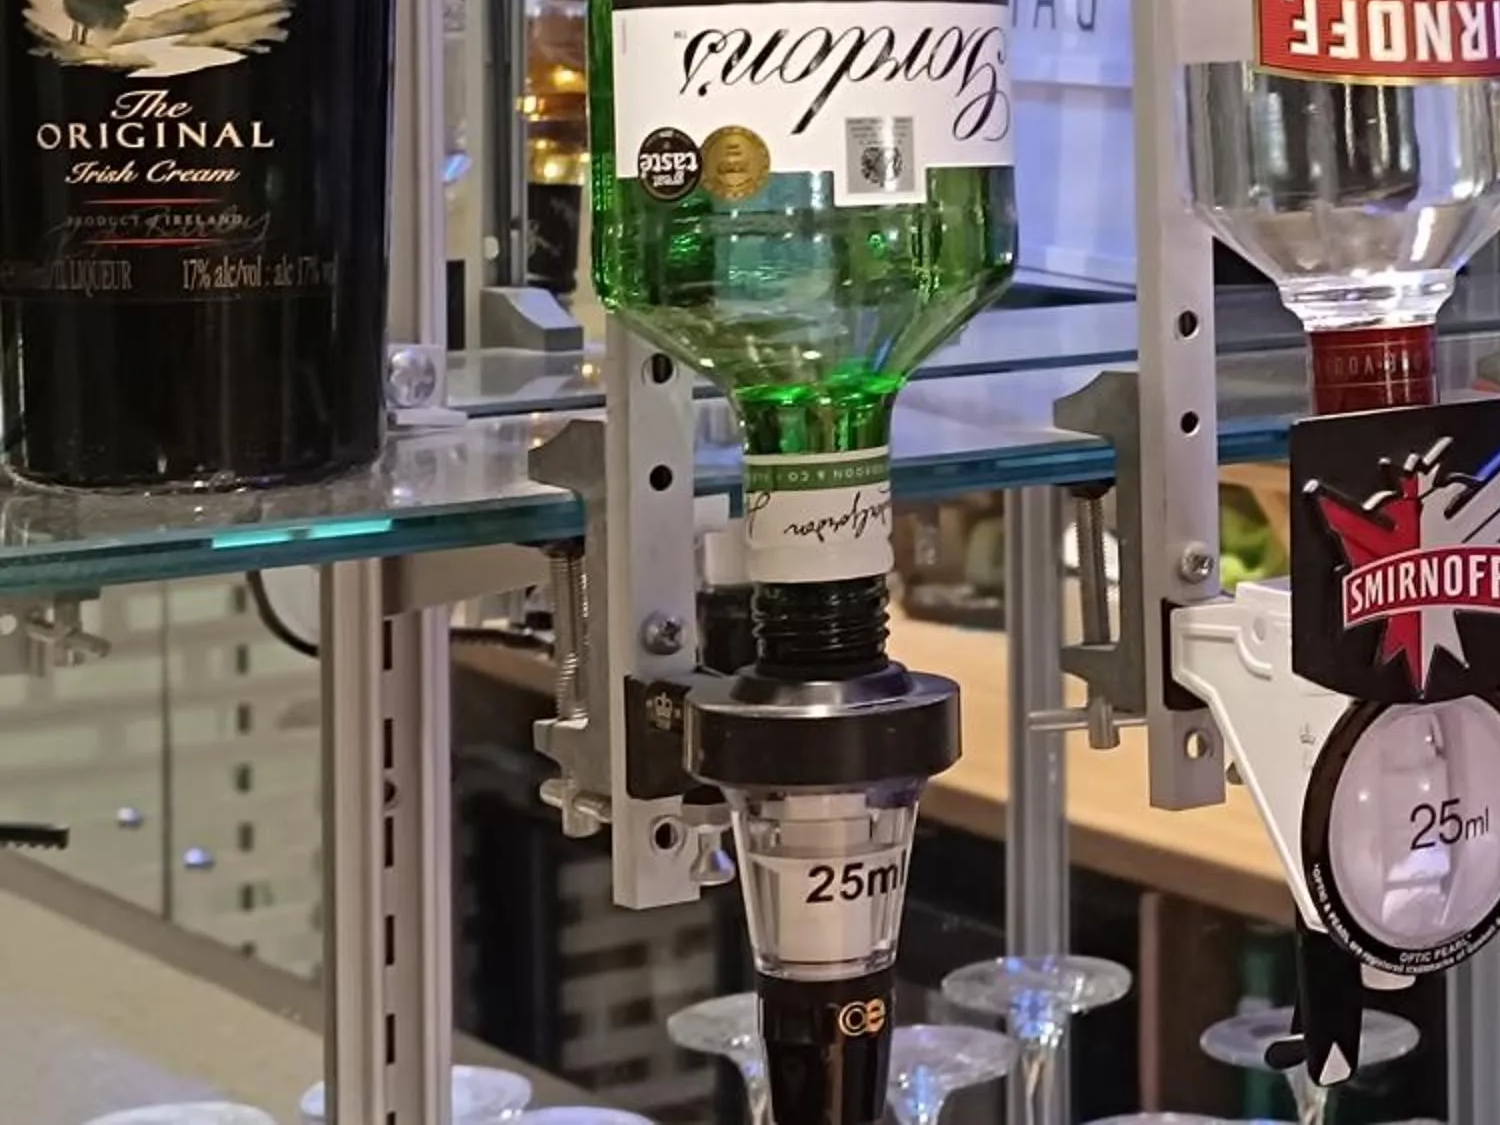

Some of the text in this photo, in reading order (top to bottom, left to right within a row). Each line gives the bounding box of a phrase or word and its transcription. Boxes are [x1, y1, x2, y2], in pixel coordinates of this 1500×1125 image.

[680, 26, 1009, 142] Gordon's
[110, 89, 193, 120] The
[36, 120, 276, 151] ORIGINAL
[64, 159, 241, 184] Irish Cream
[638, 151, 699, 178] taste
[182, 258, 212, 291] 17%
[1407, 798, 1491, 851] 25ml
[805, 860, 903, 905] 25m
